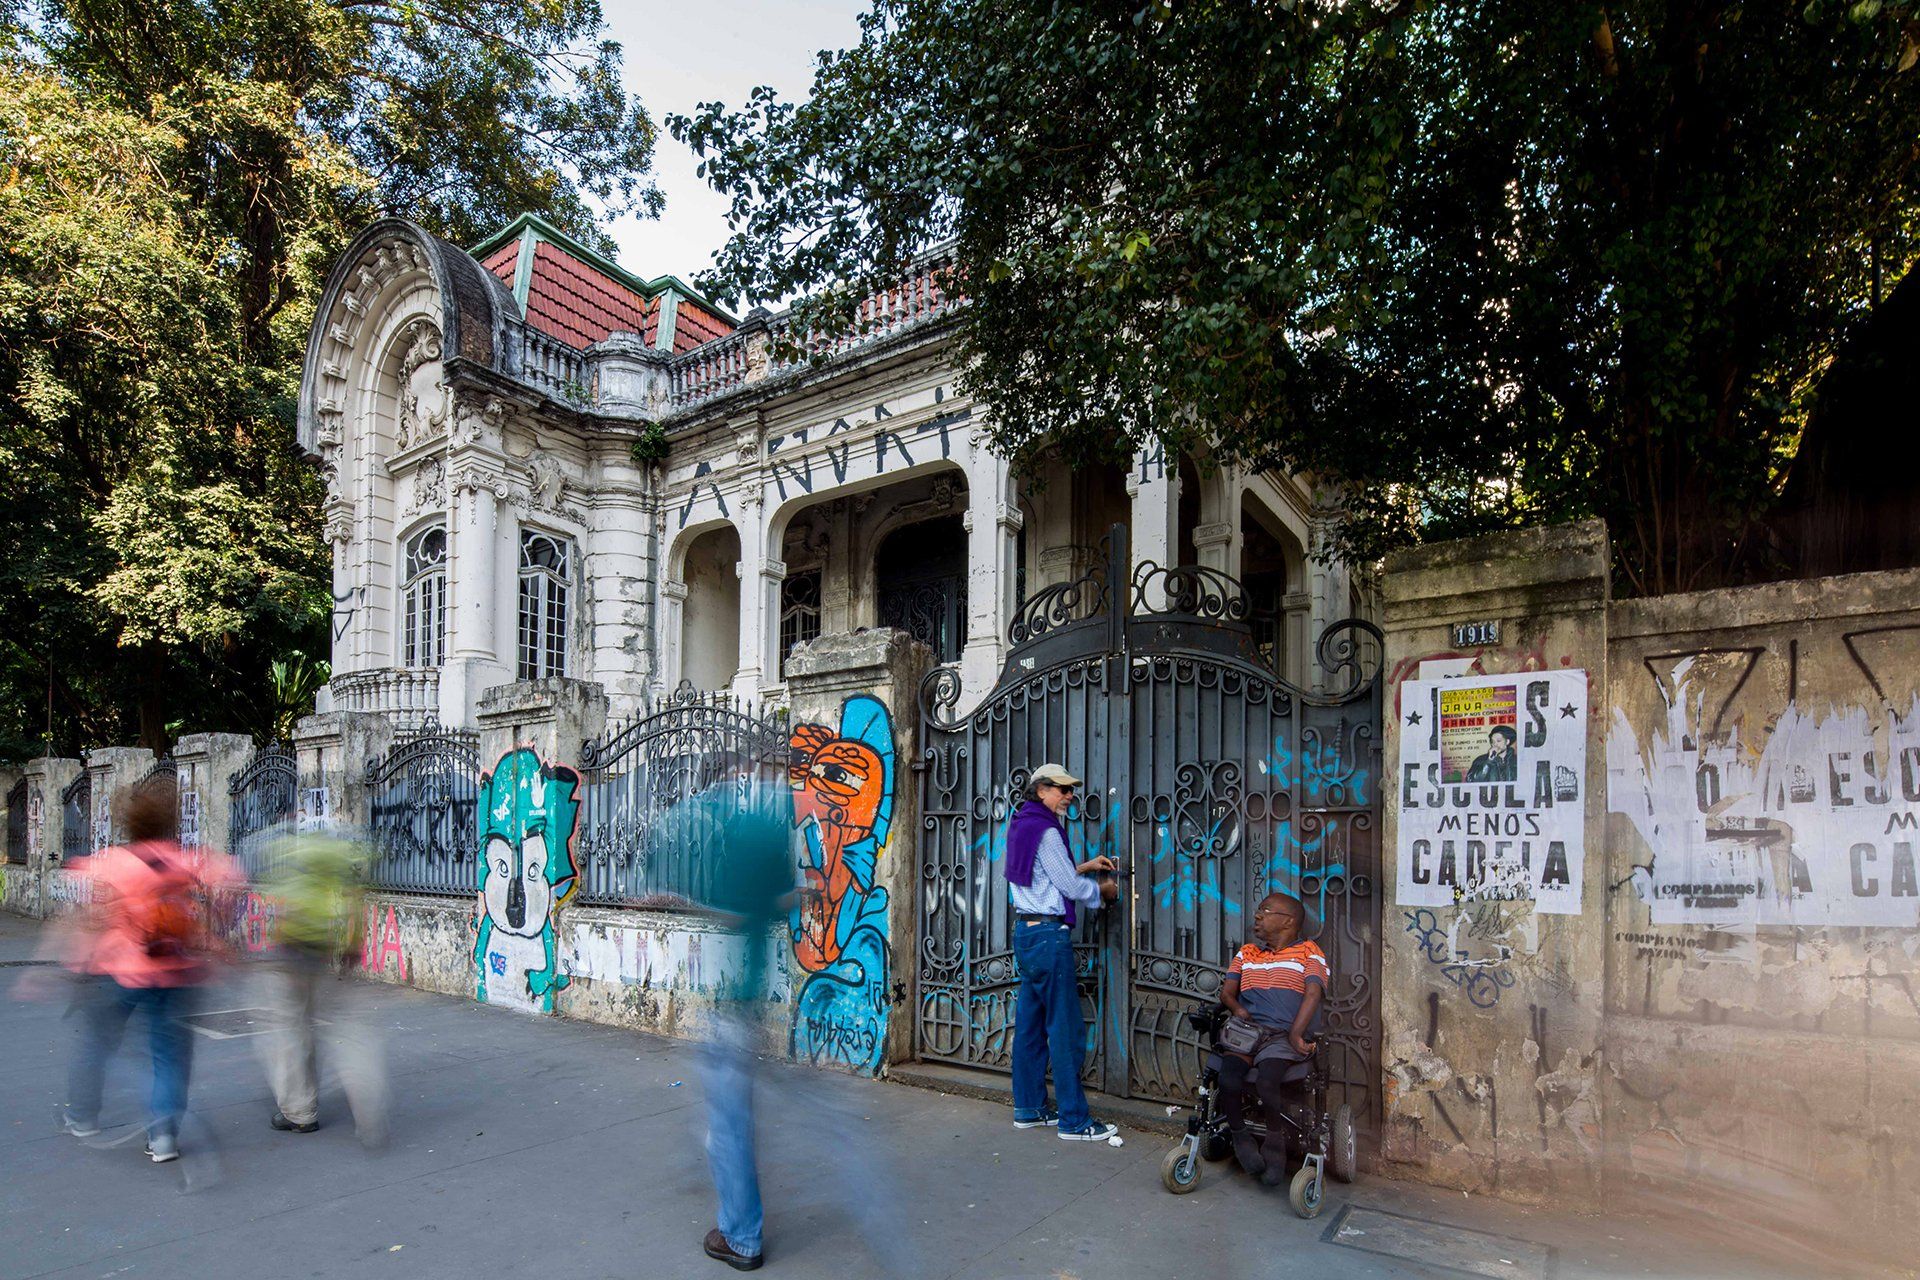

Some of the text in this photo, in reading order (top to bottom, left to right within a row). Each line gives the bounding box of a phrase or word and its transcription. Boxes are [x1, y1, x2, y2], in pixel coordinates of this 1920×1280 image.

[1443, 702, 1482, 713] JAVA
[1437, 813, 1541, 837] MENOS
[1661, 883, 1755, 896] COMPRAMOS
